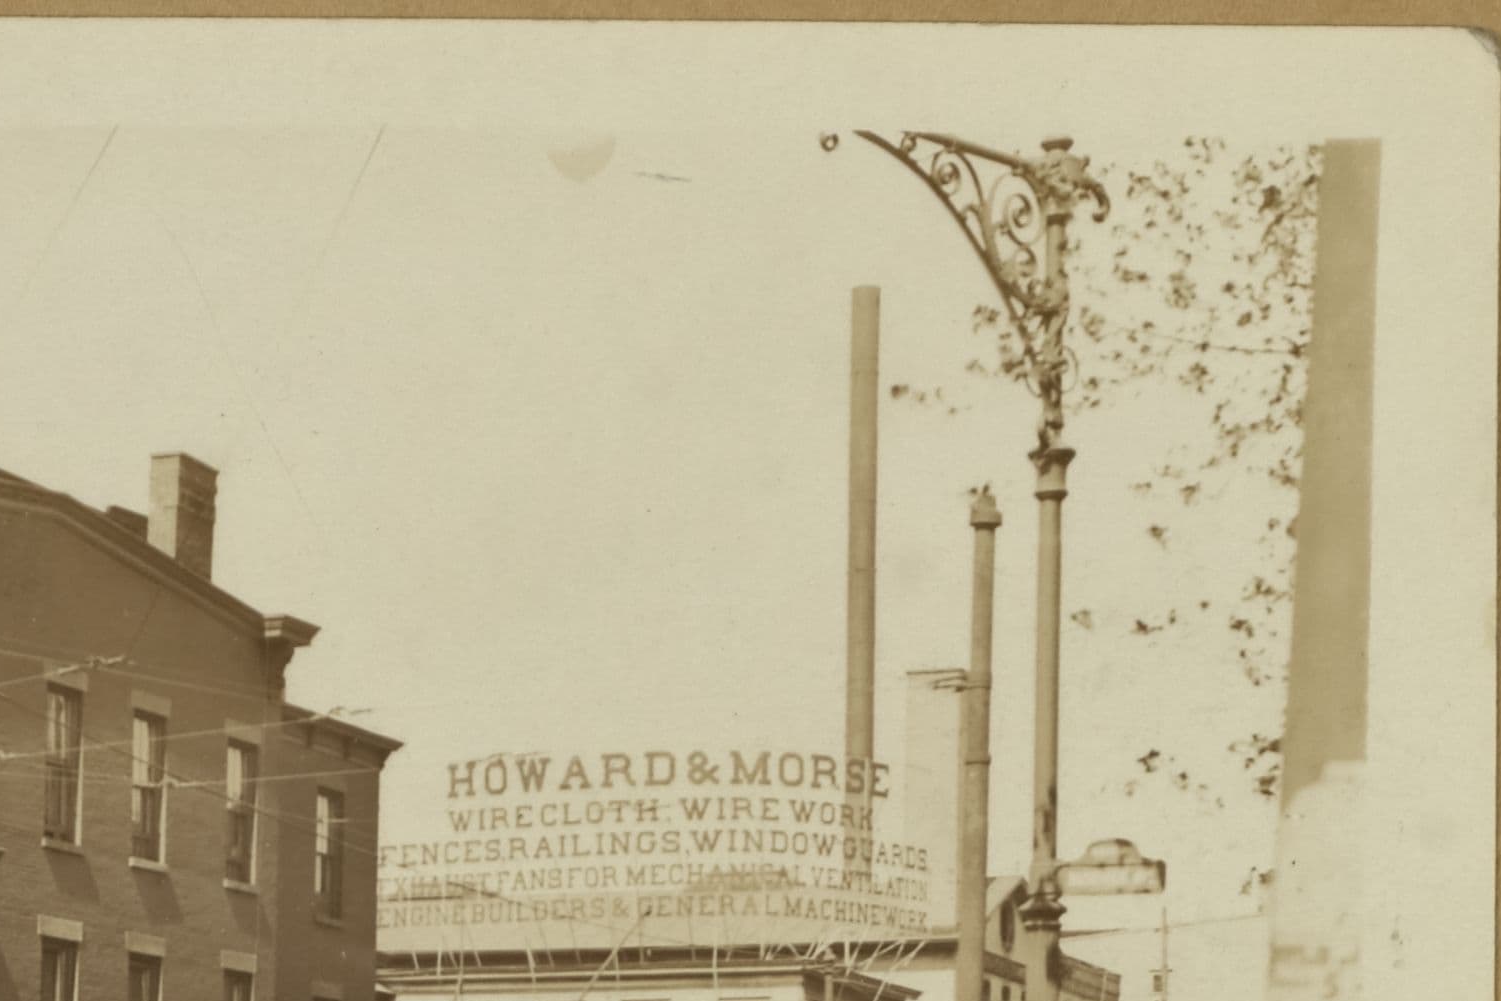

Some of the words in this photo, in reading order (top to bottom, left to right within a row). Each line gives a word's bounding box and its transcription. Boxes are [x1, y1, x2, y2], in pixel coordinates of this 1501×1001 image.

[446, 751, 677, 799] HOWARD
[687, 750, 720, 786] &
[729, 750, 891, 798] MORSE
[679, 796, 781, 822] WIRE
[693, 829, 837, 857] WINDOW
[497, 867, 562, 892] FANS
[567, 866, 617, 889] FOR
[625, 862, 807, 890] MECHANICAL
[377, 903, 469, 929] ENGINE
